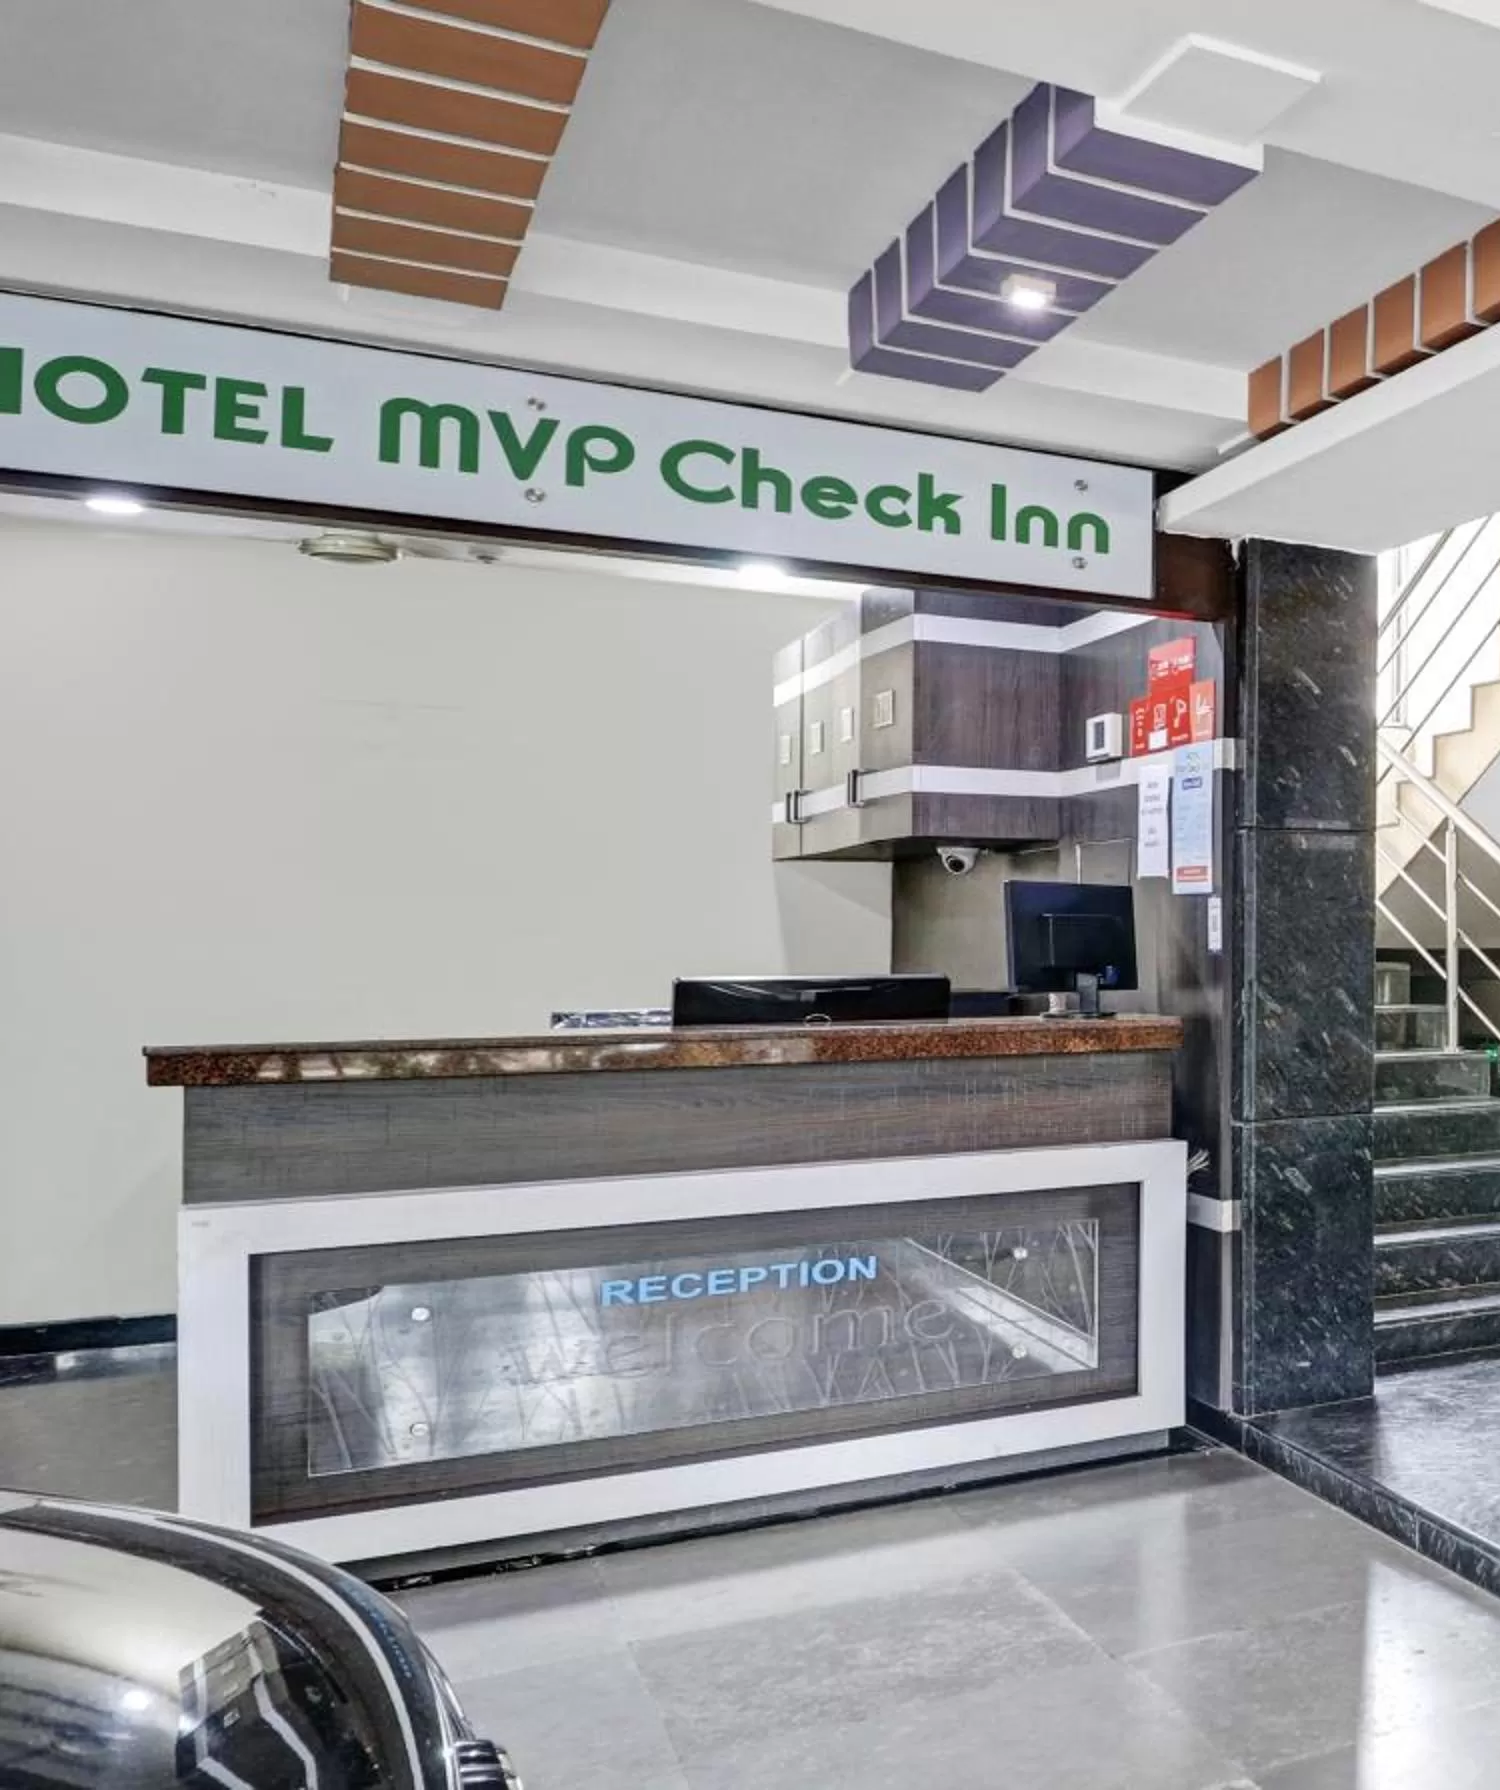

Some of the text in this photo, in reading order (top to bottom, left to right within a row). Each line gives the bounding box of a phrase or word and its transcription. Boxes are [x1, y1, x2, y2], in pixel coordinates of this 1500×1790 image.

[660, 439, 961, 534] Check
[991, 483, 1109, 553] Inn
[600, 1254, 878, 1307] RECEPTION
